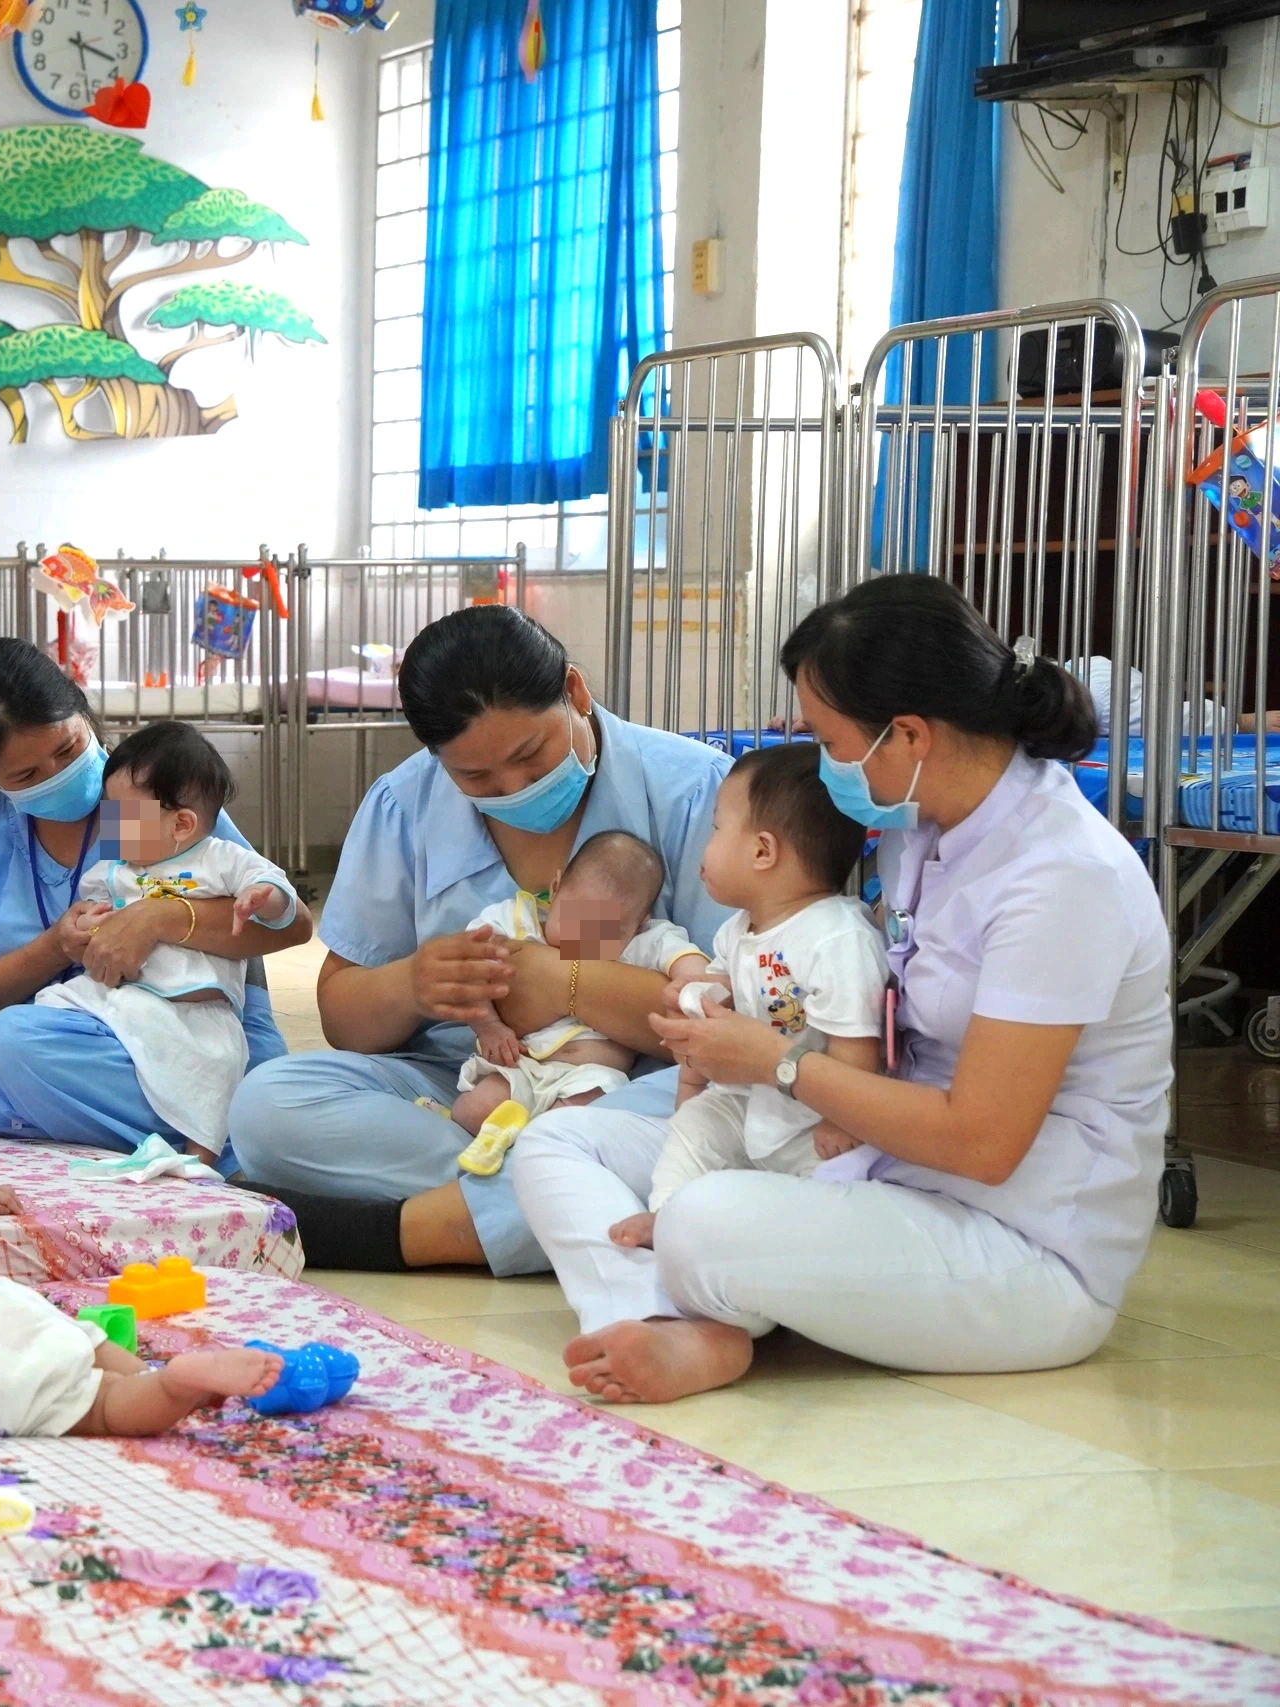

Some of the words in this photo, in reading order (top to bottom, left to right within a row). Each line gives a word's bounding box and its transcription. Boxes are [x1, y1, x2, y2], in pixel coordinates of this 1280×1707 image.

[113, 19, 126, 36] 2
[32, 29, 44, 46] 9
[116, 42, 129, 60] 3
[33, 53, 46, 71] 8
[107, 65, 119, 80] 4
[50, 73, 63, 90] 7
[68, 83, 81, 100] 6
